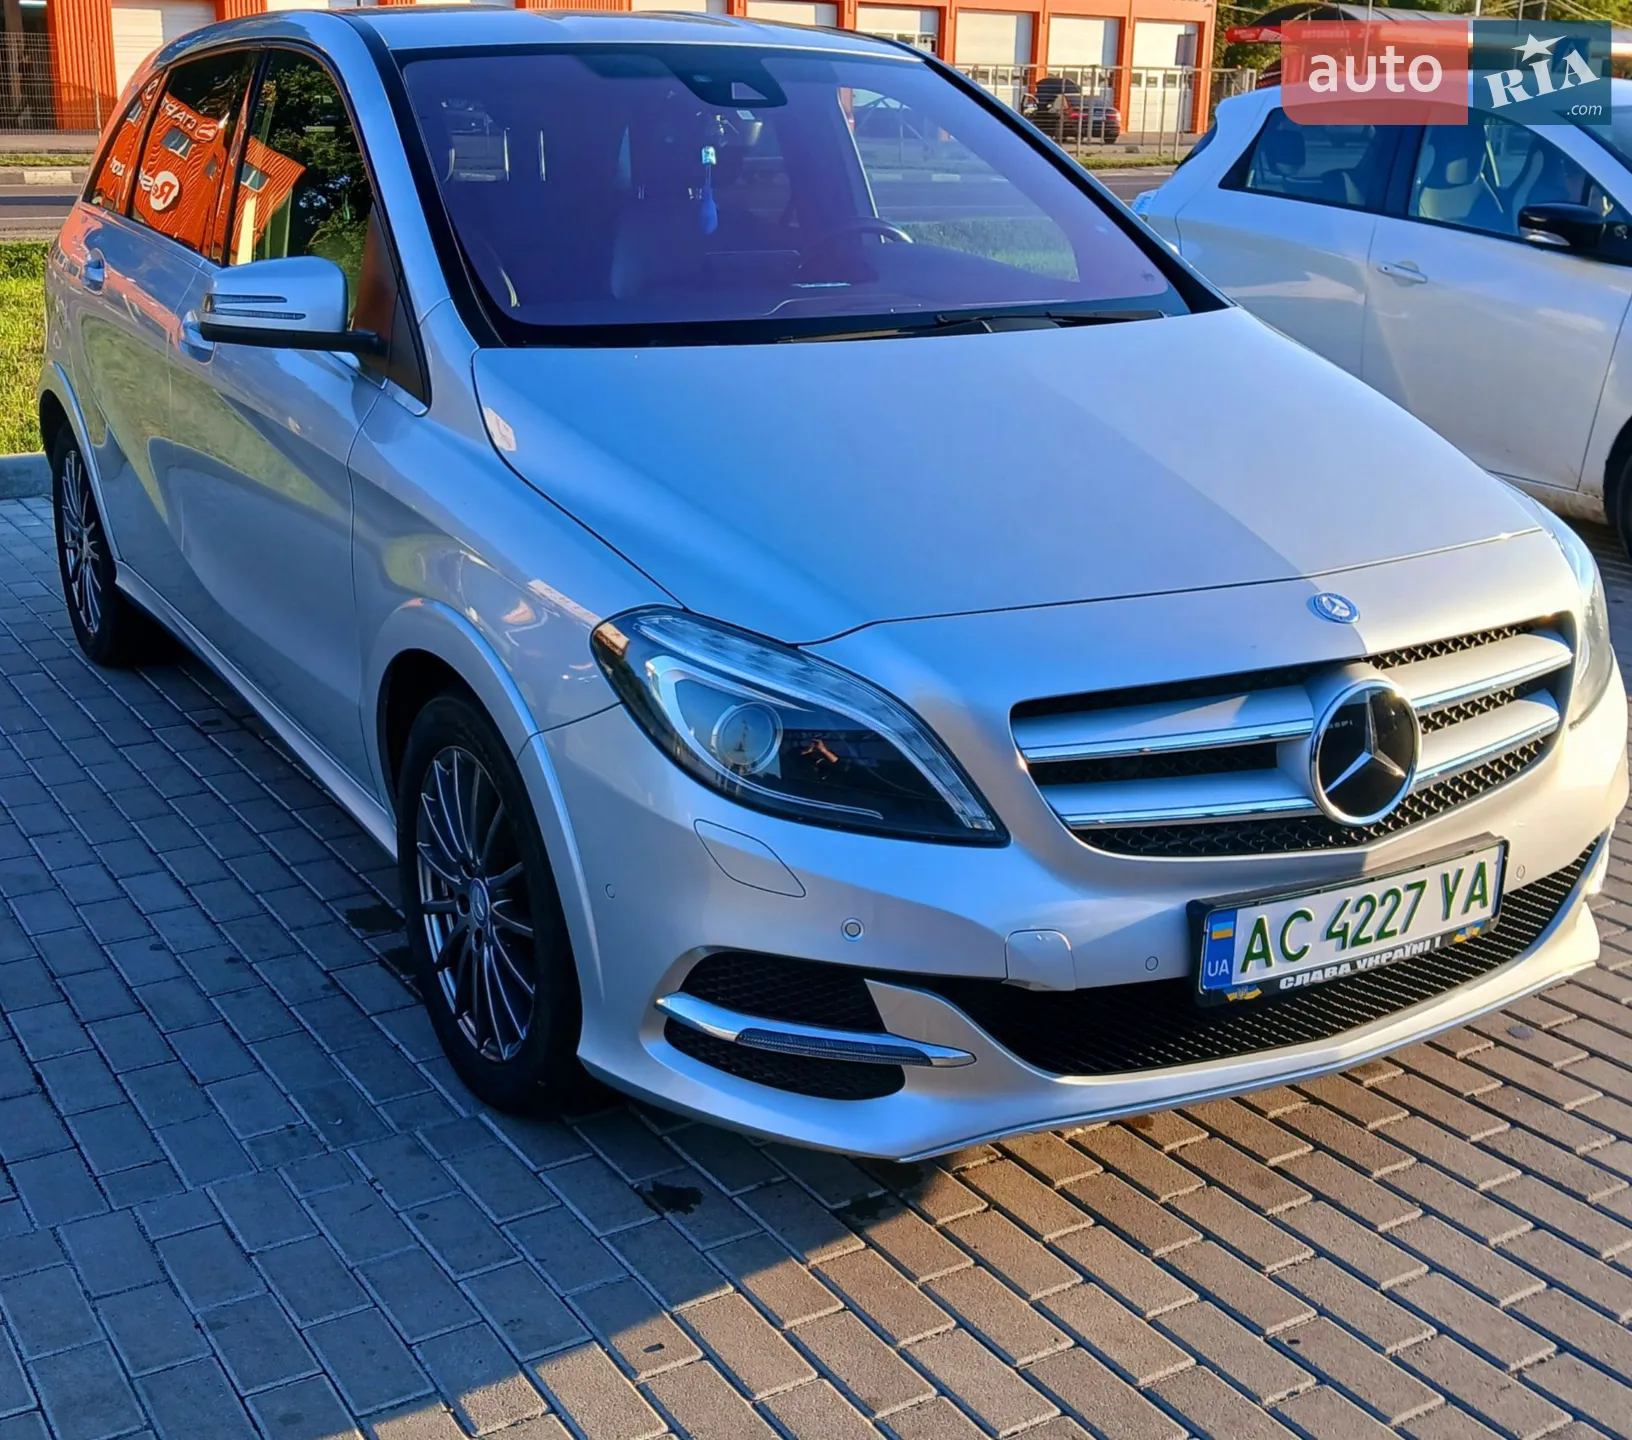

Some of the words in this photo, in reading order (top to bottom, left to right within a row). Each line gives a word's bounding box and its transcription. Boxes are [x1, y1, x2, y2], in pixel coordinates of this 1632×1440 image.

[1239, 908, 1314, 974] AC
[1324, 879, 1428, 951] 4227
[1440, 861, 1489, 921] YA
[1207, 960, 1230, 978] UA
[1279, 964, 1351, 991] СЛАВА
